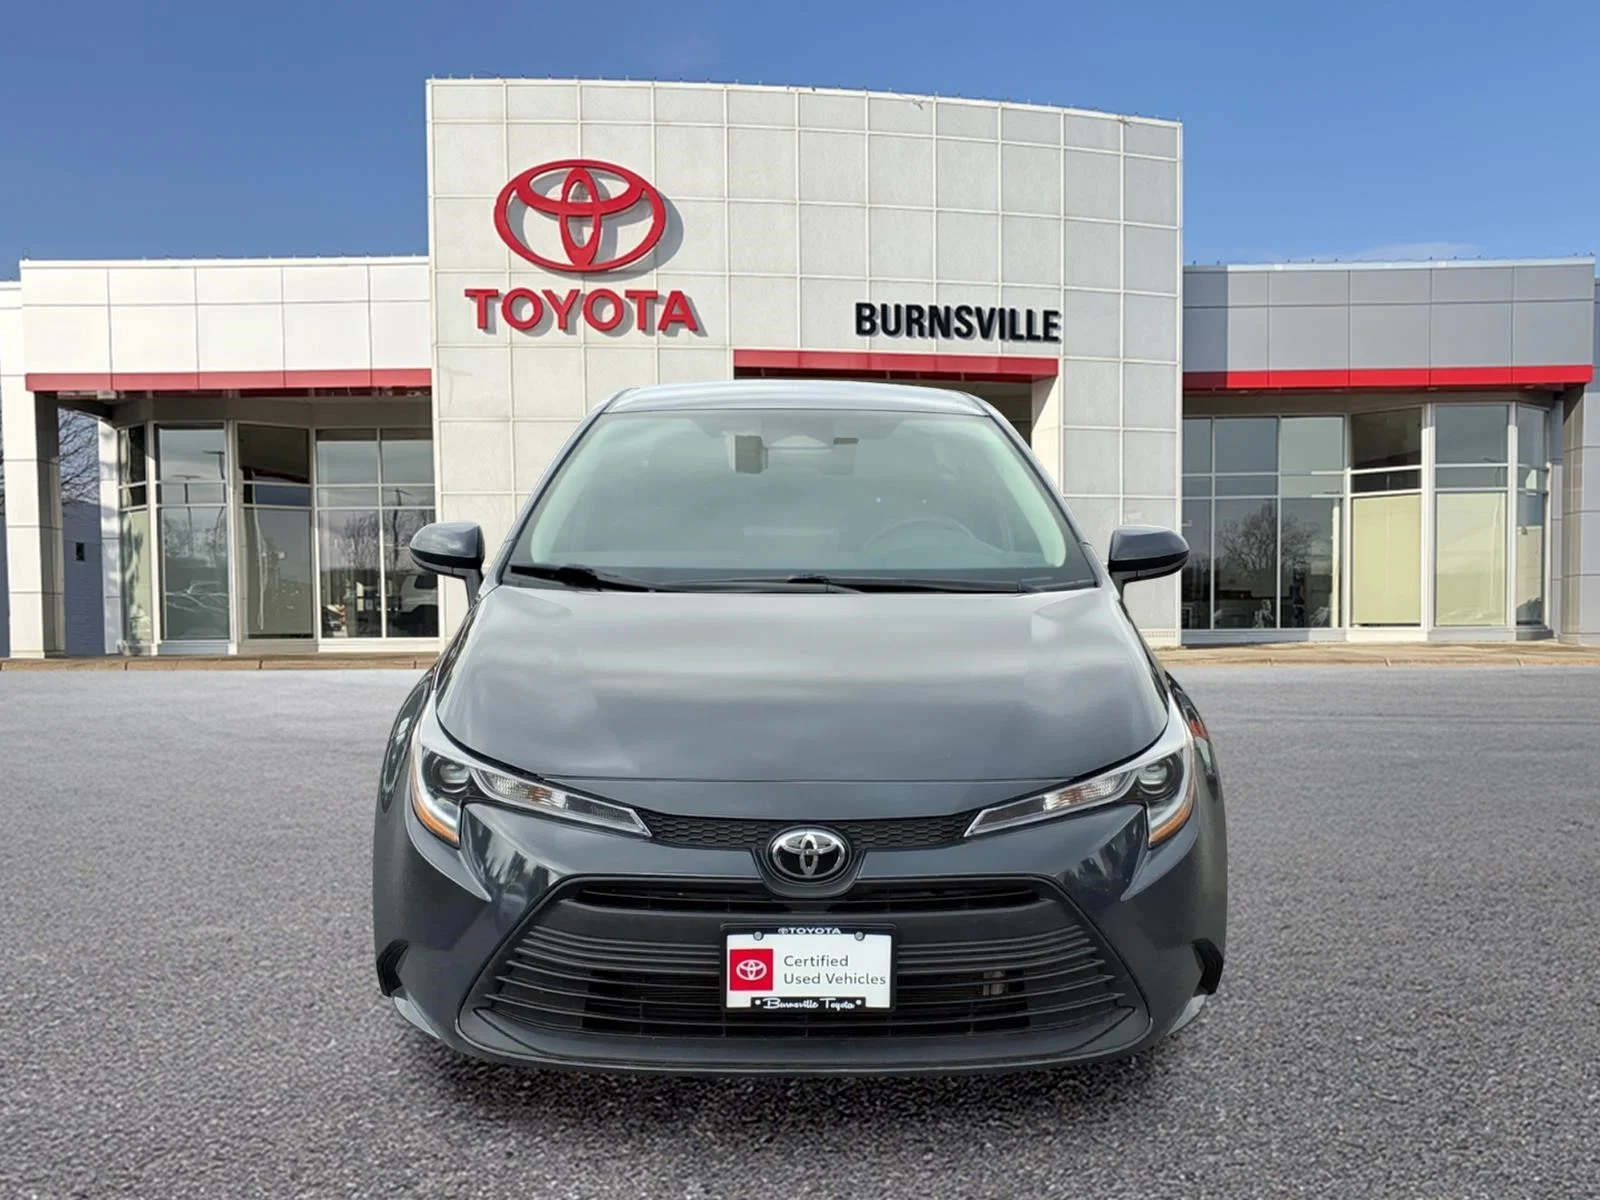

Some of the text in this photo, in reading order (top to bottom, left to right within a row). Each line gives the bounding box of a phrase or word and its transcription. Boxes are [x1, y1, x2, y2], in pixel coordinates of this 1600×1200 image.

[464, 287, 699, 332] TOYOTA
[855, 302, 1061, 342] BURNSVILLE
[789, 927, 842, 935] TOYOTA
[783, 955, 849, 967] Certified
[783, 973, 887, 985] Used Vehicles
[762, 997, 855, 1012] Burnsville Toyota
